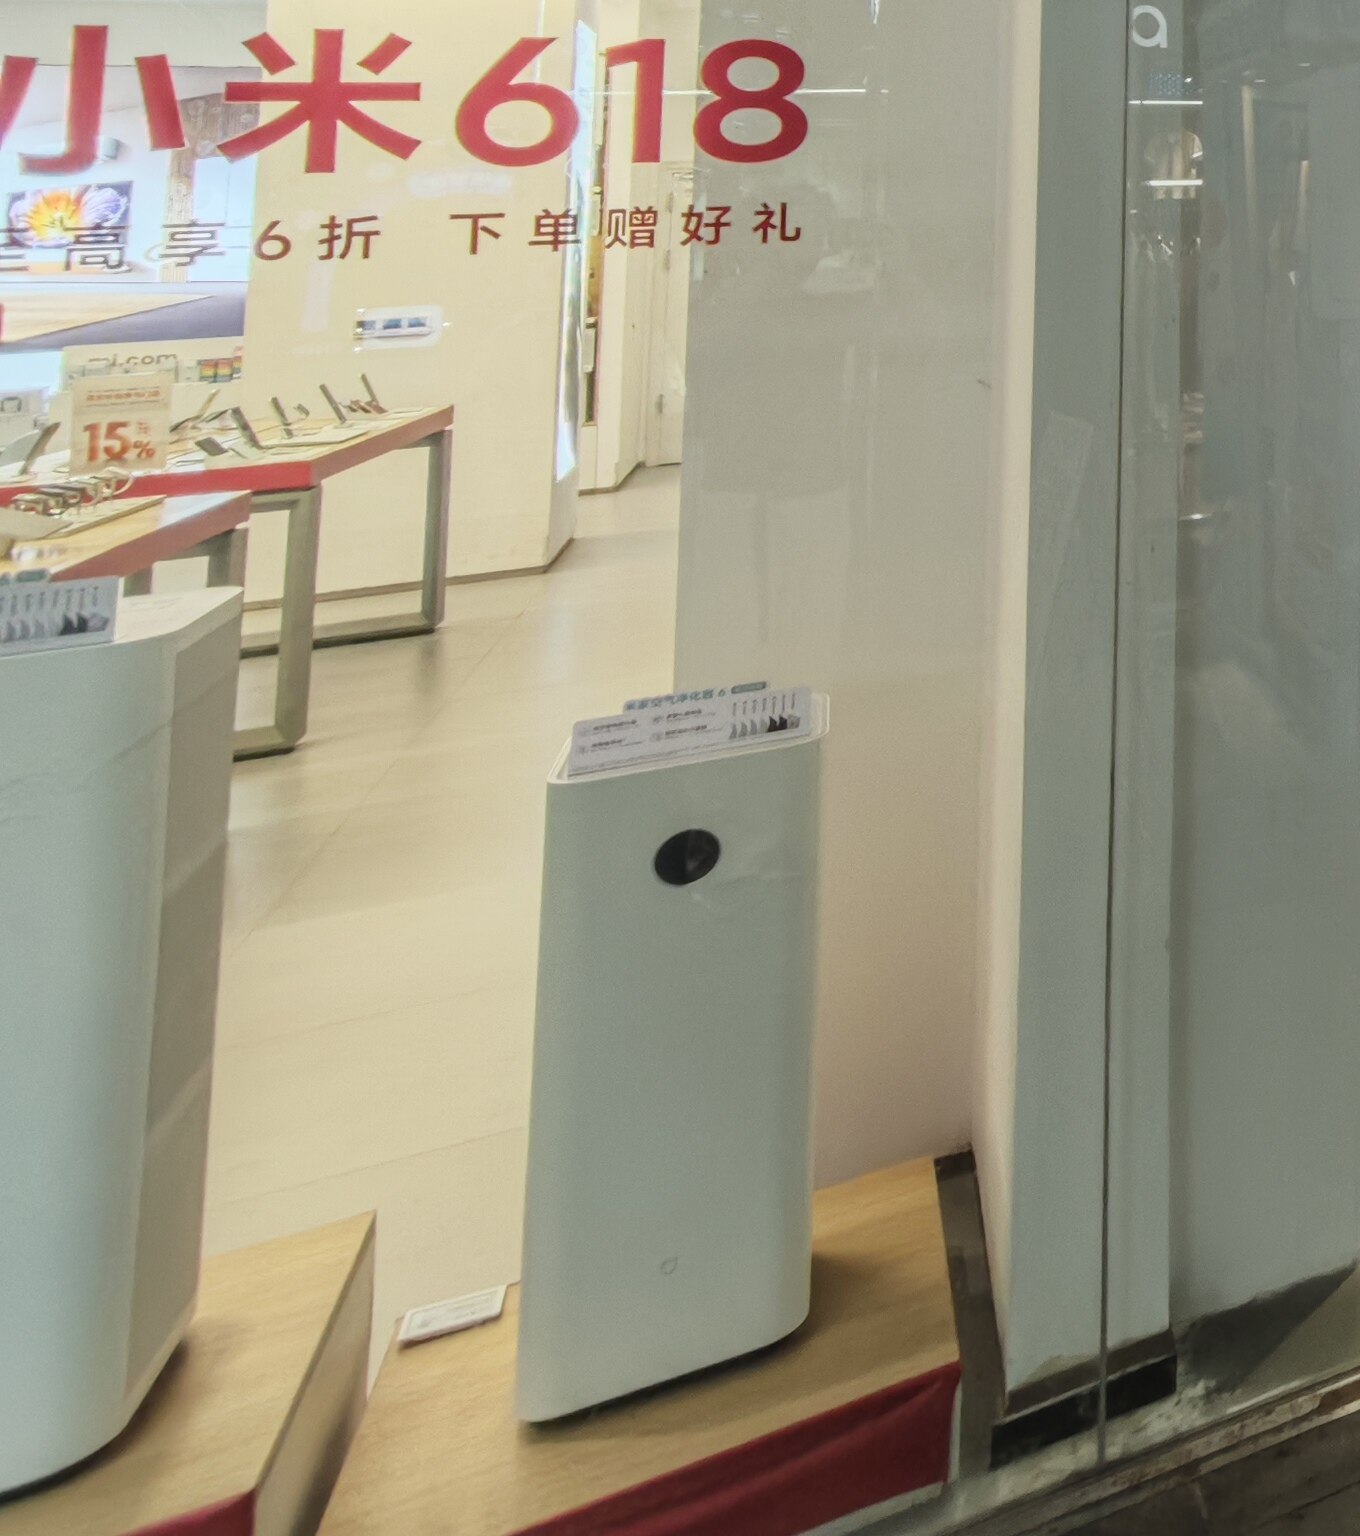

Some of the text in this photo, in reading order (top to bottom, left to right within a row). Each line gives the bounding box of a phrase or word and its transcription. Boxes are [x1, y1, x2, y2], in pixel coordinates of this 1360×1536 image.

[0, 25, 809, 174] 小米618
[450, 201, 802, 256] 下单赠好礼
